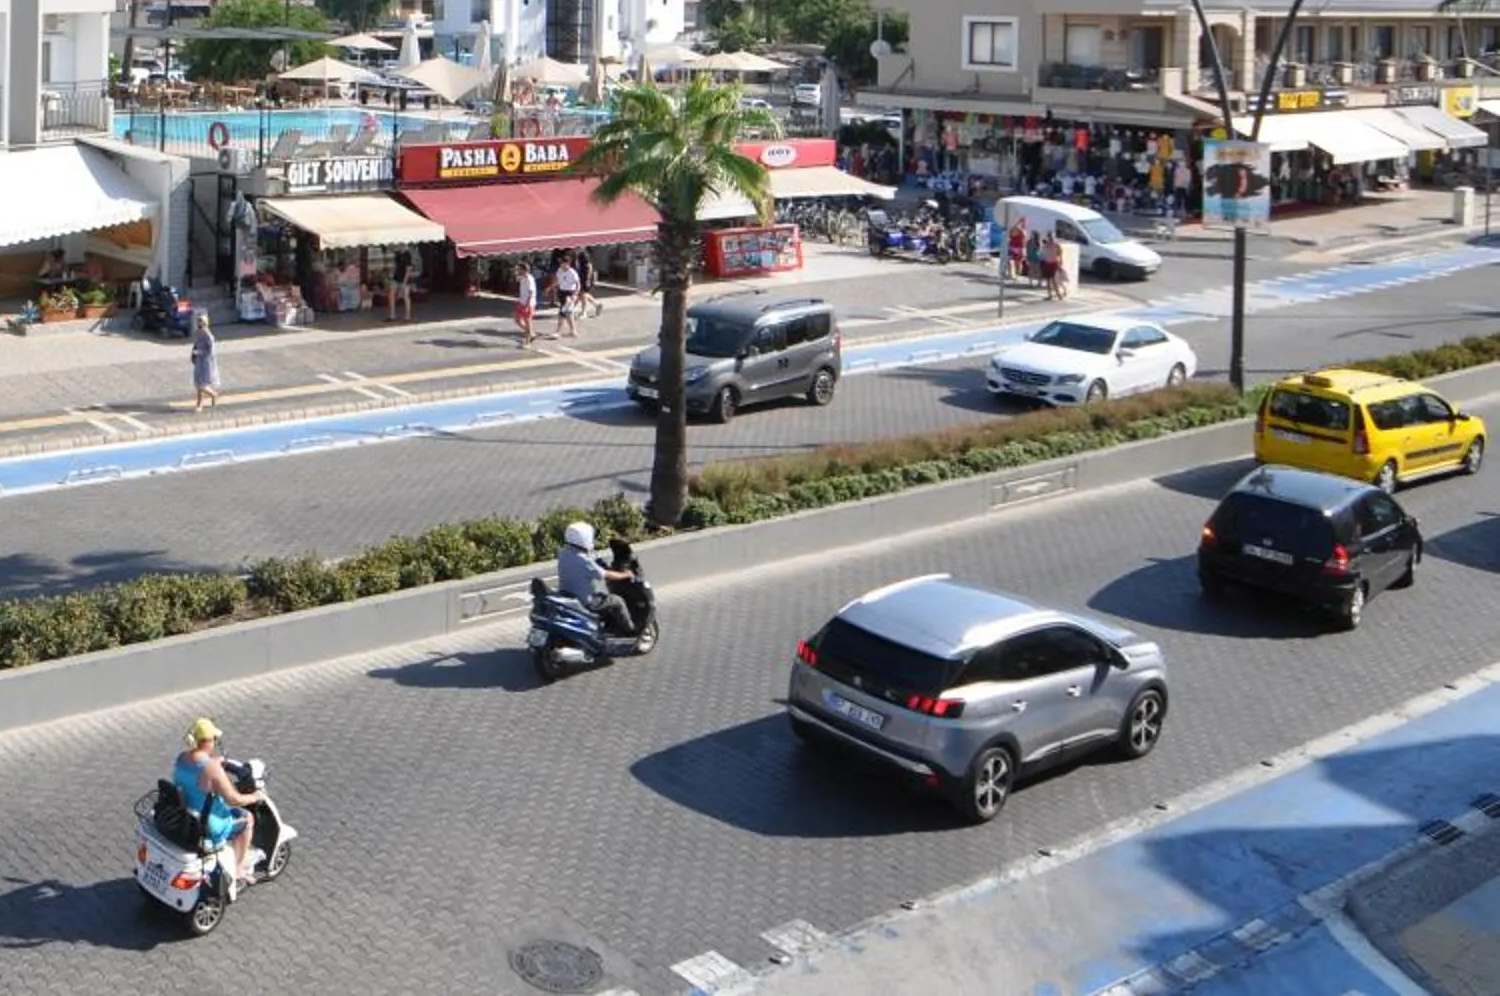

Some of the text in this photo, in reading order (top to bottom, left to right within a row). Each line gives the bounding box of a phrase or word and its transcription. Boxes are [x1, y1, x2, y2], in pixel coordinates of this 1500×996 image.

[441, 143, 569, 168] PASHA BABA
[288, 161, 320, 184] GIFT
